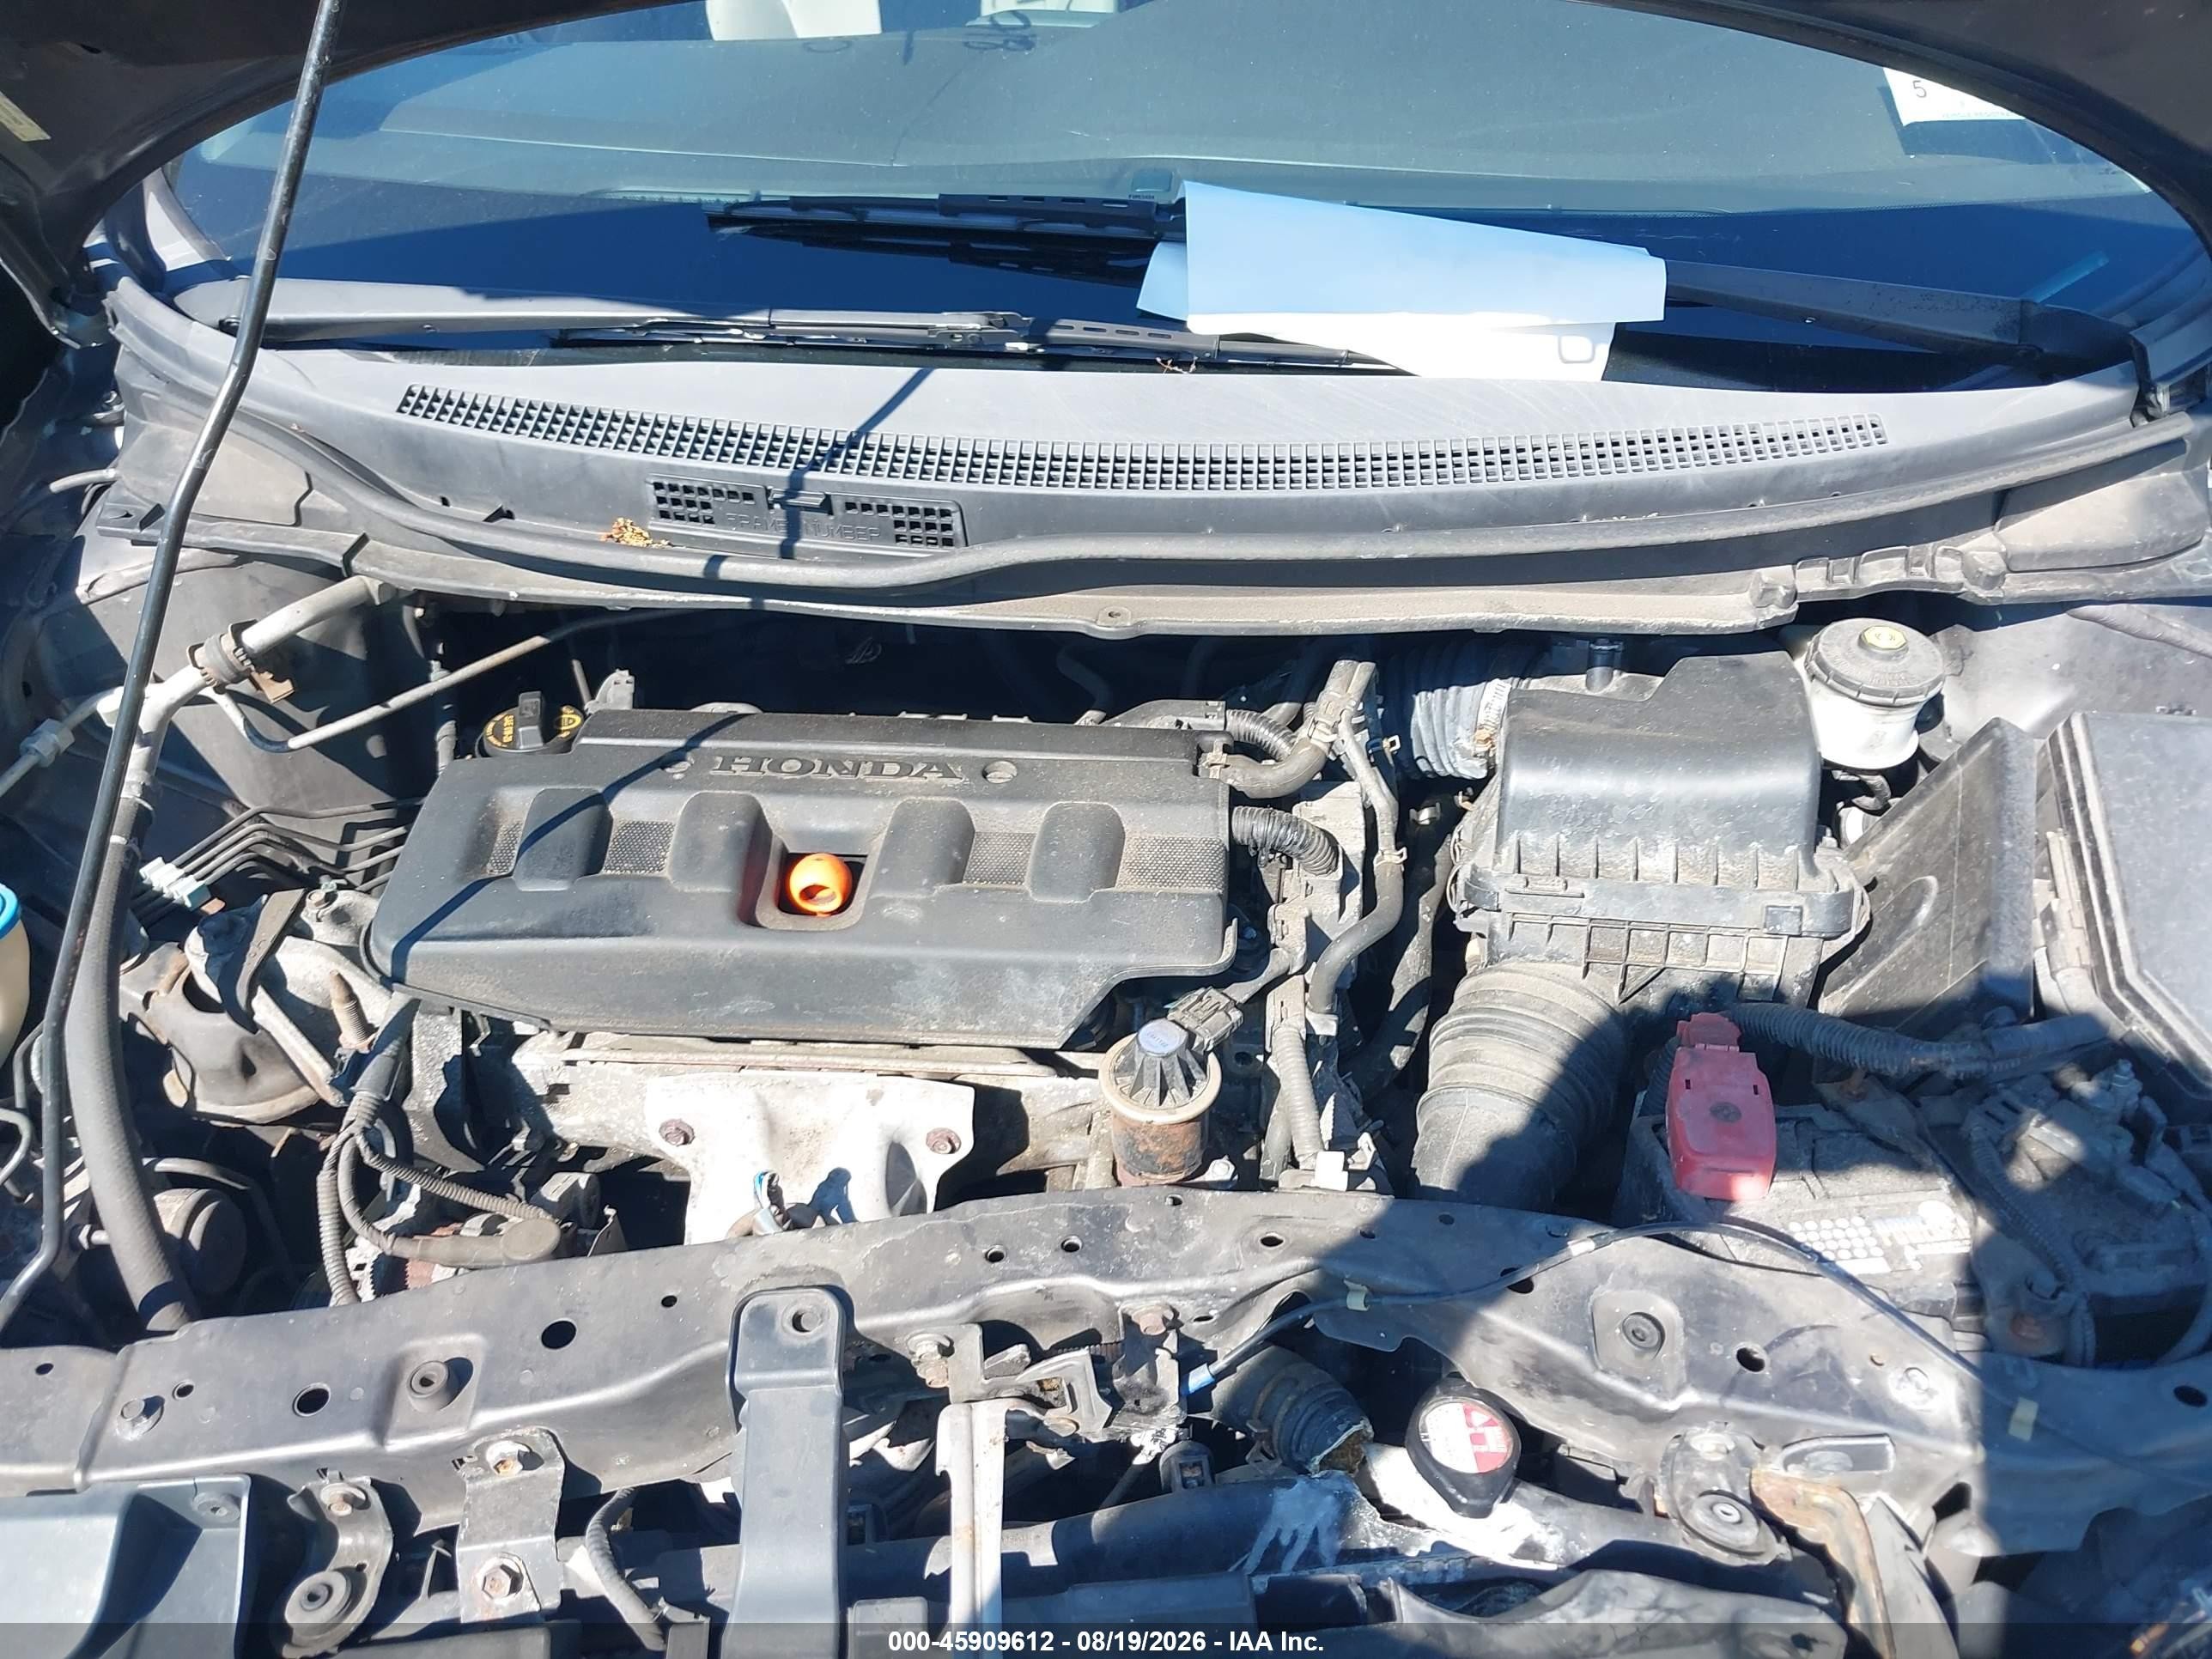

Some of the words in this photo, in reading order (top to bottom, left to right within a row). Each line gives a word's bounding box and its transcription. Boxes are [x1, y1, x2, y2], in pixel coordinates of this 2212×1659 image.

[1912, 80, 1927, 98] 5
[726, 513, 787, 536] FRAME
[805, 520, 882, 541] NUMBER
[711, 755, 963, 781] HONDA
